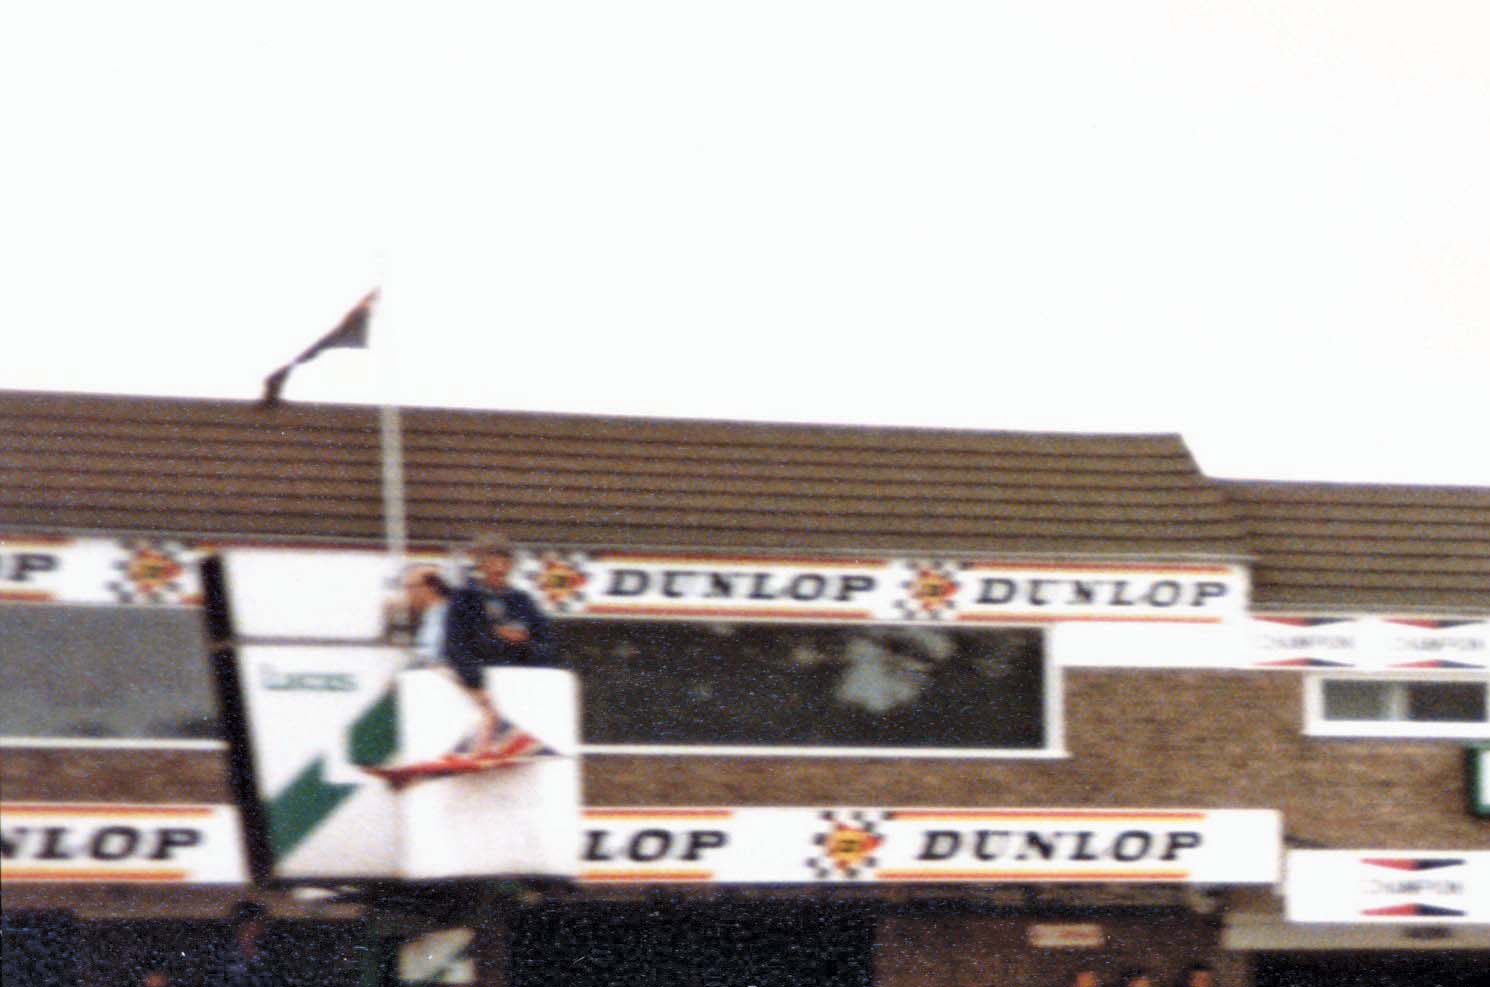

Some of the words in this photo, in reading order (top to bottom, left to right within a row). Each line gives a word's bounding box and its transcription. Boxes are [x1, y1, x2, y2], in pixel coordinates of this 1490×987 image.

[606, 567, 876, 602] DUNLOP
[975, 575, 1229, 608] DUNLOP
[581, 828, 729, 863] LOP
[916, 829, 1203, 863] DUNLOP
